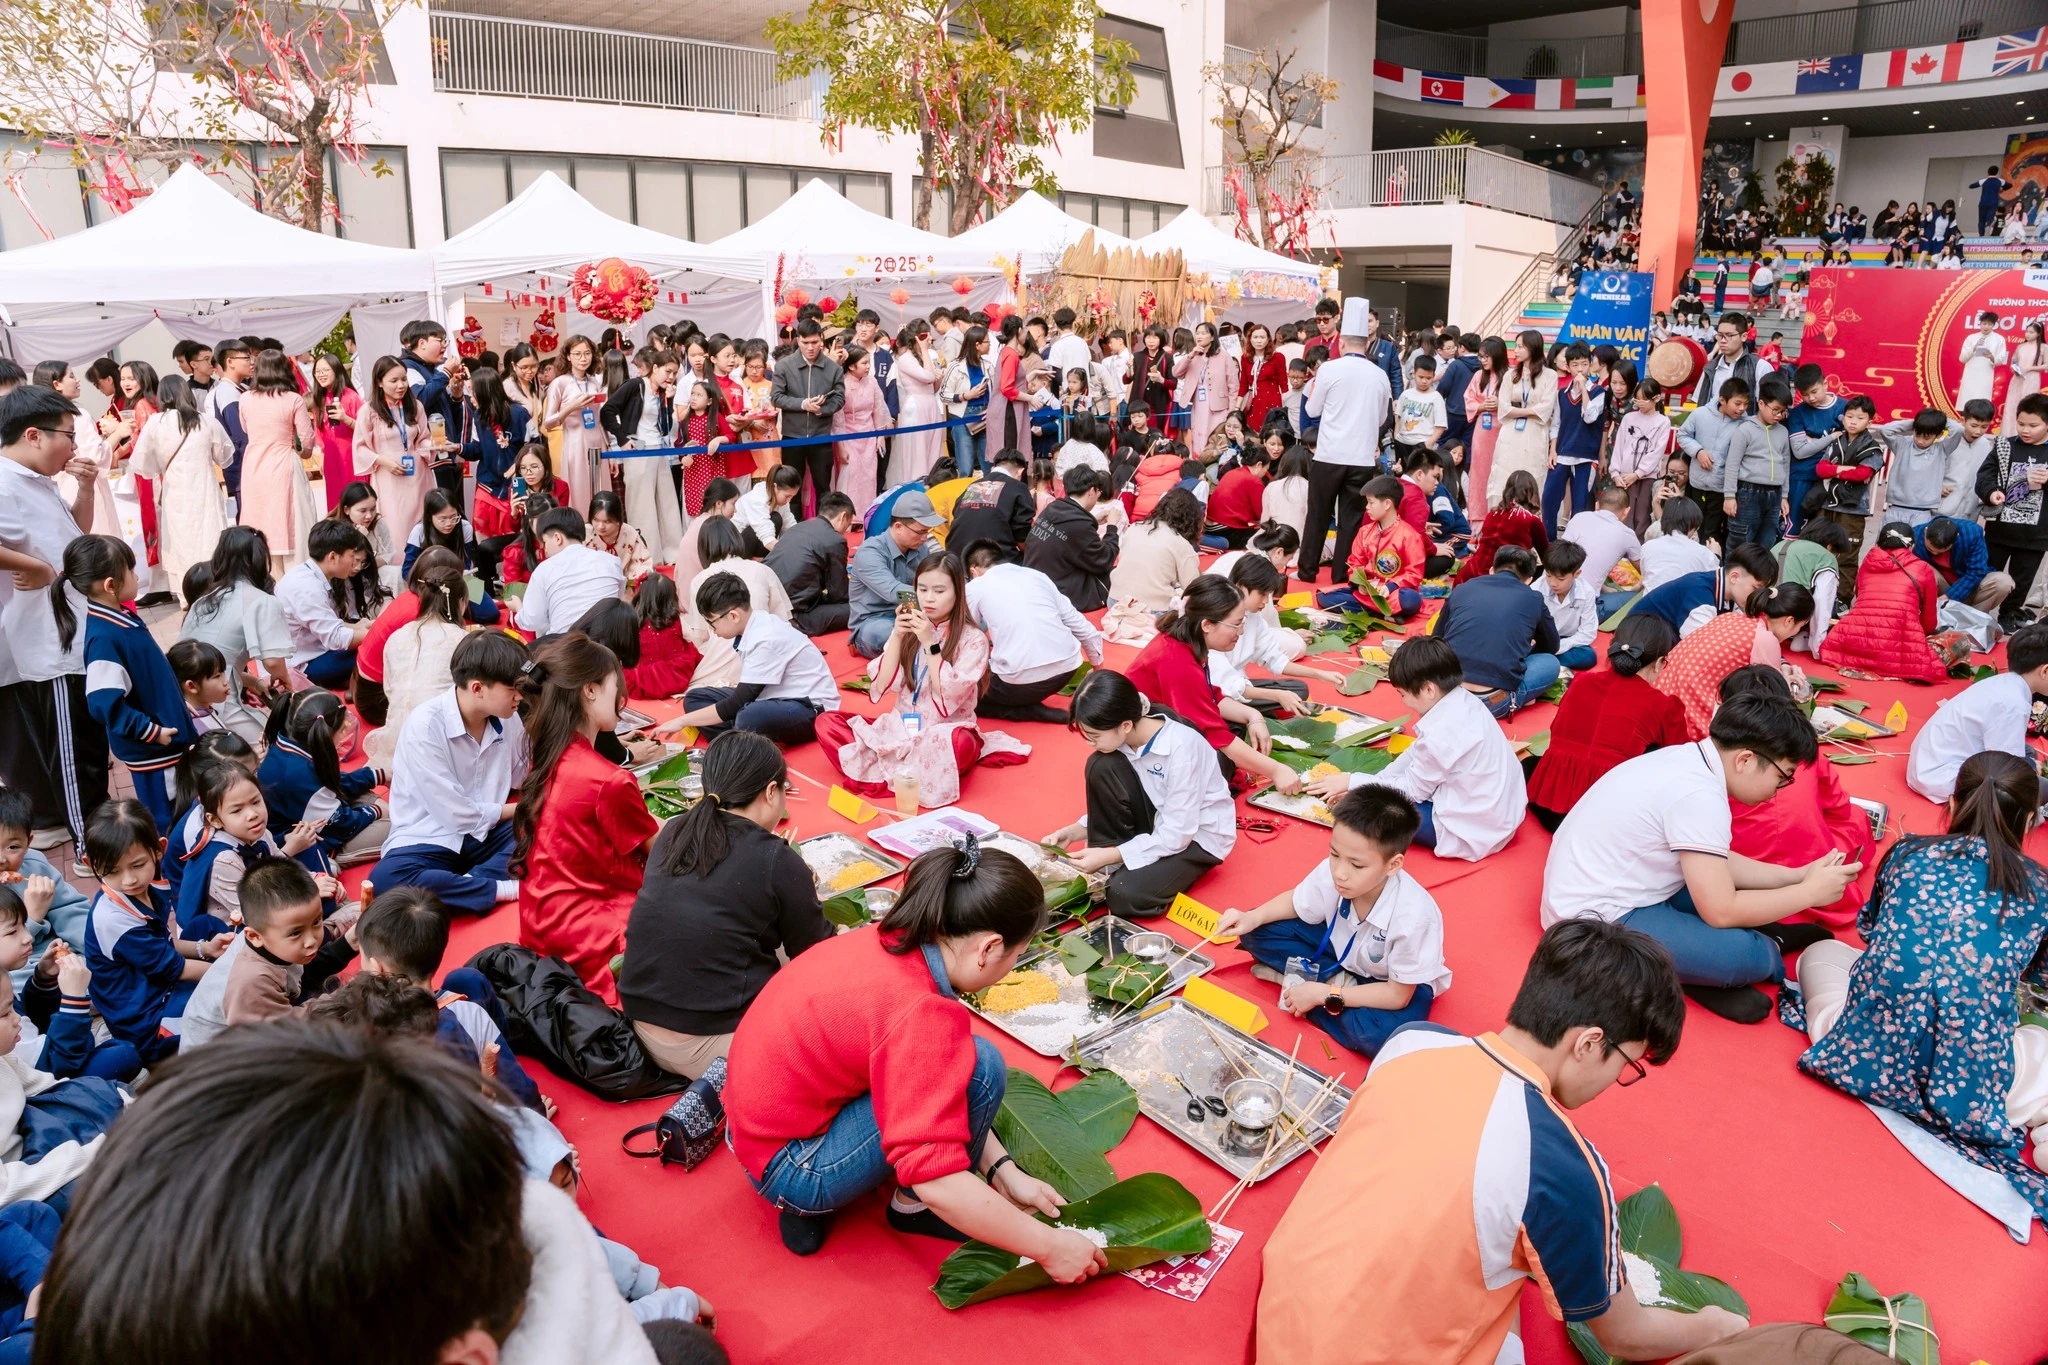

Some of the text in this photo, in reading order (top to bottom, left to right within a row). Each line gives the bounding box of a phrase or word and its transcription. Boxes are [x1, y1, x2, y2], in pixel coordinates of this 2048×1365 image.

[1988, 297, 2026, 307] TRƯỜNG
[1570, 323, 1647, 342] NHÂN VĂN
[1055, 529, 1068, 542] vie
[1176, 905, 1198, 922] LỚP
